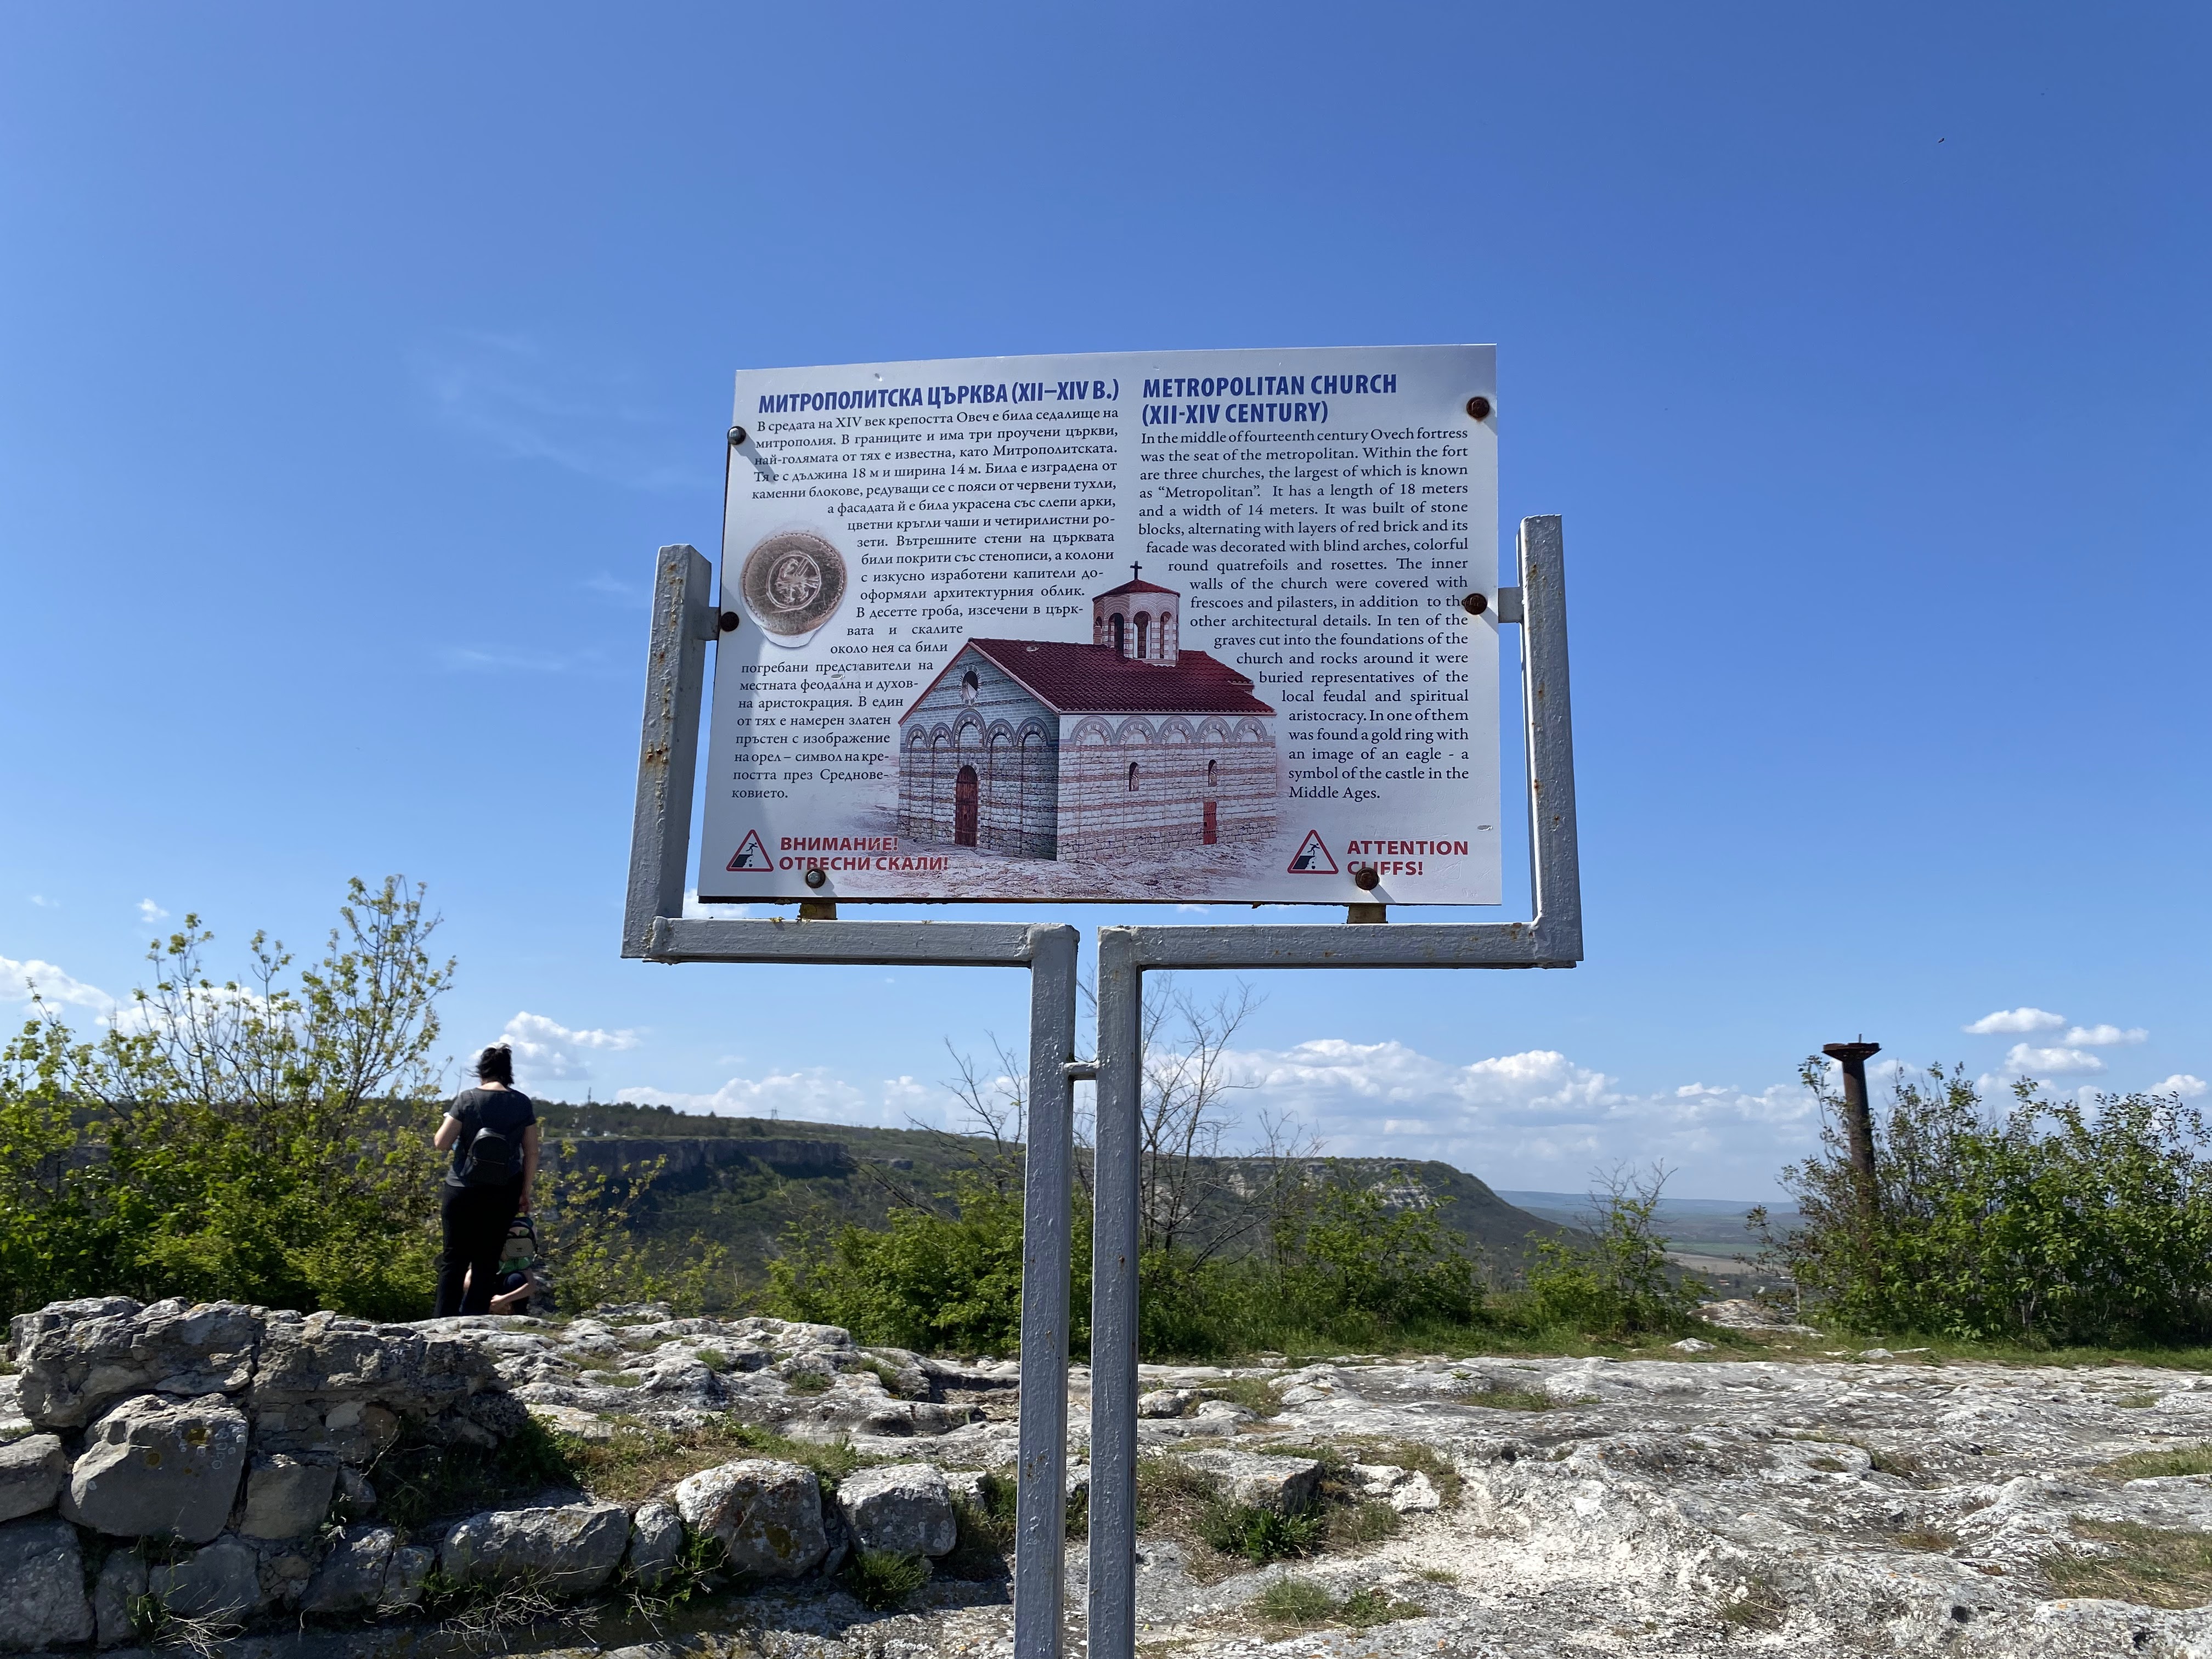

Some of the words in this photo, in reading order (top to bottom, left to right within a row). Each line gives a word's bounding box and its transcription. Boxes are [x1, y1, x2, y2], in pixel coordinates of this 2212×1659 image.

[1143, 375, 1305, 398] METROPOLITAN
[1311, 374, 1397, 394] CHURCH
[758, 387, 923, 414] МИТРОПОЛИТСКА
[928, 385, 1008, 410] ЦЪРКВА
[1142, 404, 1221, 427] (XII-XIV
[1225, 400, 1328, 424] CENTURY)
[755, 438, 836, 450] митрополия.
[841, 434, 850, 444] В
[854, 434, 922, 448] границите
[939, 432, 964, 441] има
[968, 431, 992, 443] три
[997, 429, 1060, 442] проучени
[1065, 427, 1118, 440] църкви,
[755, 454, 838, 465] най-голямата
[842, 454, 857, 462] от
[860, 453, 881, 461] тях
[884, 452, 891, 460] е
[895, 450, 956, 460] известна,
[960, 449, 989, 457] като
[992, 444, 1118, 459] Митрополитската.
[1140, 454, 1165, 462] was
[1169, 449, 1190, 461] the
[1193, 452, 1220, 461] seat
[1223, 448, 1239, 461] of
[1240, 448, 1262, 460] the
[1266, 447, 1358, 463] metropolitan.
[1362, 446, 1412, 458] Within
[1415, 445, 1438, 458] the
[1442, 444, 1468, 457] fort
[1140, 472, 1160, 481] are
[1164, 467, 1198, 480] three
[1201, 467, 1265, 480] churches,
[1268, 466, 1290, 478] the
[1294, 466, 1339, 482] largest
[1342, 465, 1359, 477] of
[1360, 464, 1402, 477] which
[1406, 465, 1417, 476] is
[1420, 464, 1468, 476] known
[752, 490, 806, 499] каменни
[809, 486, 863, 497] блокове,
[865, 486, 929, 499] редуващи
[932, 484, 945, 493] се
[957, 483, 996, 492] пояси
[999, 483, 1014, 491] от
[1016, 481, 1071, 494] червени
[1073, 481, 1116, 493] тухли,
[848, 521, 893, 532] цветни
[896, 520, 941, 532] кръгли
[944, 519, 980, 527] чаши
[995, 516, 1090, 529] четирилистни
[1092, 516, 1115, 528] ро-
[857, 539, 888, 548] зети.
[896, 535, 977, 549] Вътрешните
[984, 535, 1022, 544] стени
[1029, 535, 1045, 543] на
[1053, 533, 1115, 546] църквата
[1146, 541, 1189, 553] facade
[1192, 544, 1217, 552] was
[1220, 540, 1286, 552] decorated
[1289, 539, 1320, 552] with
[1323, 539, 1360, 552] blind
[1363, 539, 1410, 552] arches,
[1413, 537, 1469, 551] colorful
[861, 553, 893, 565] били
[896, 555, 952, 567] покрити
[954, 554, 976, 562] със
[979, 552, 1052, 562] стенописи,
[1065, 551, 1114, 560] колони
[1168, 559, 1209, 572] round
[1217, 558, 1288, 575] quatrefoils
[1297, 558, 1323, 571] and
[1331, 561, 1387, 571] rosettes.
[1396, 557, 1423, 569] The
[1431, 557, 1469, 569] inner
[861, 574, 868, 583] с
[873, 573, 925, 585] изкусно
[930, 568, 1007, 584] изработени
[1013, 570, 1076, 579] капители
[1081, 569, 1104, 580] до-
[1189, 577, 1223, 590] walls
[1231, 577, 1246, 590] of
[1251, 577, 1273, 590] the
[1281, 577, 1328, 589] church
[1335, 580, 1368, 589] were
[1375, 575, 1429, 589] covered
[1436, 575, 1468, 588] with
[860, 589, 927, 603] оформяли
[933, 589, 1034, 602] архитектурния
[1041, 584, 1085, 596] облик.
[1190, 596, 1244, 608] frescoes
[1248, 596, 1273, 608] and
[1276, 595, 1337, 612] pilasters,
[1341, 596, 1355, 607] in
[1359, 595, 1419, 607] addition
[1427, 598, 1441, 607] to
[847, 627, 874, 636] вата
[911, 625, 963, 634] скалите
[1236, 652, 1283, 664] church
[1289, 651, 1315, 664] and
[1320, 652, 1358, 664] rocks
[1363, 651, 1414, 664] around
[1419, 652, 1430, 664] it
[1435, 654, 1468, 663] were
[741, 661, 809, 677] погребани
[815, 663, 911, 675] представители
[740, 682, 797, 691] местната
[800, 679, 861, 693] феодална
[865, 681, 873, 689] и
[876, 680, 918, 692] духов-
[1259, 670, 1304, 683] buried
[1311, 671, 1415, 687] representatives
[1423, 669, 1440, 682] of
[1446, 670, 1469, 682] the
[738, 700, 753, 709] на
[758, 699, 853, 712] аристокрация.
[857, 696, 867, 707] В
[872, 698, 904, 709] един
[1282, 690, 1314, 702] local
[1323, 689, 1367, 702] feudal
[1375, 689, 1402, 702] and
[1410, 689, 1469, 706] spiritual
[736, 736, 788, 748] пръстен
[792, 736, 799, 744] с
[803, 731, 890, 747] изображение
[1288, 732, 1314, 741] was
[1317, 727, 1359, 741] found
[1361, 732, 1369, 741] a
[1371, 727, 1403, 744] gold
[1404, 728, 1434, 744] ring
[1436, 727, 1469, 740] with
[733, 771, 777, 780] постта
[783, 772, 813, 784] през
[820, 768, 889, 784] Среднове-
[731, 790, 788, 798] ковието.
[1288, 786, 1339, 798] Middle
[1342, 787, 1380, 803] Ages.
[781, 837, 899, 851] ВНИМАНИЕ!
[1347, 840, 1469, 855] ATTENTION
[779, 856, 871, 871] ОТВЕСНИ
[876, 857, 947, 870] СКАЛИ!
